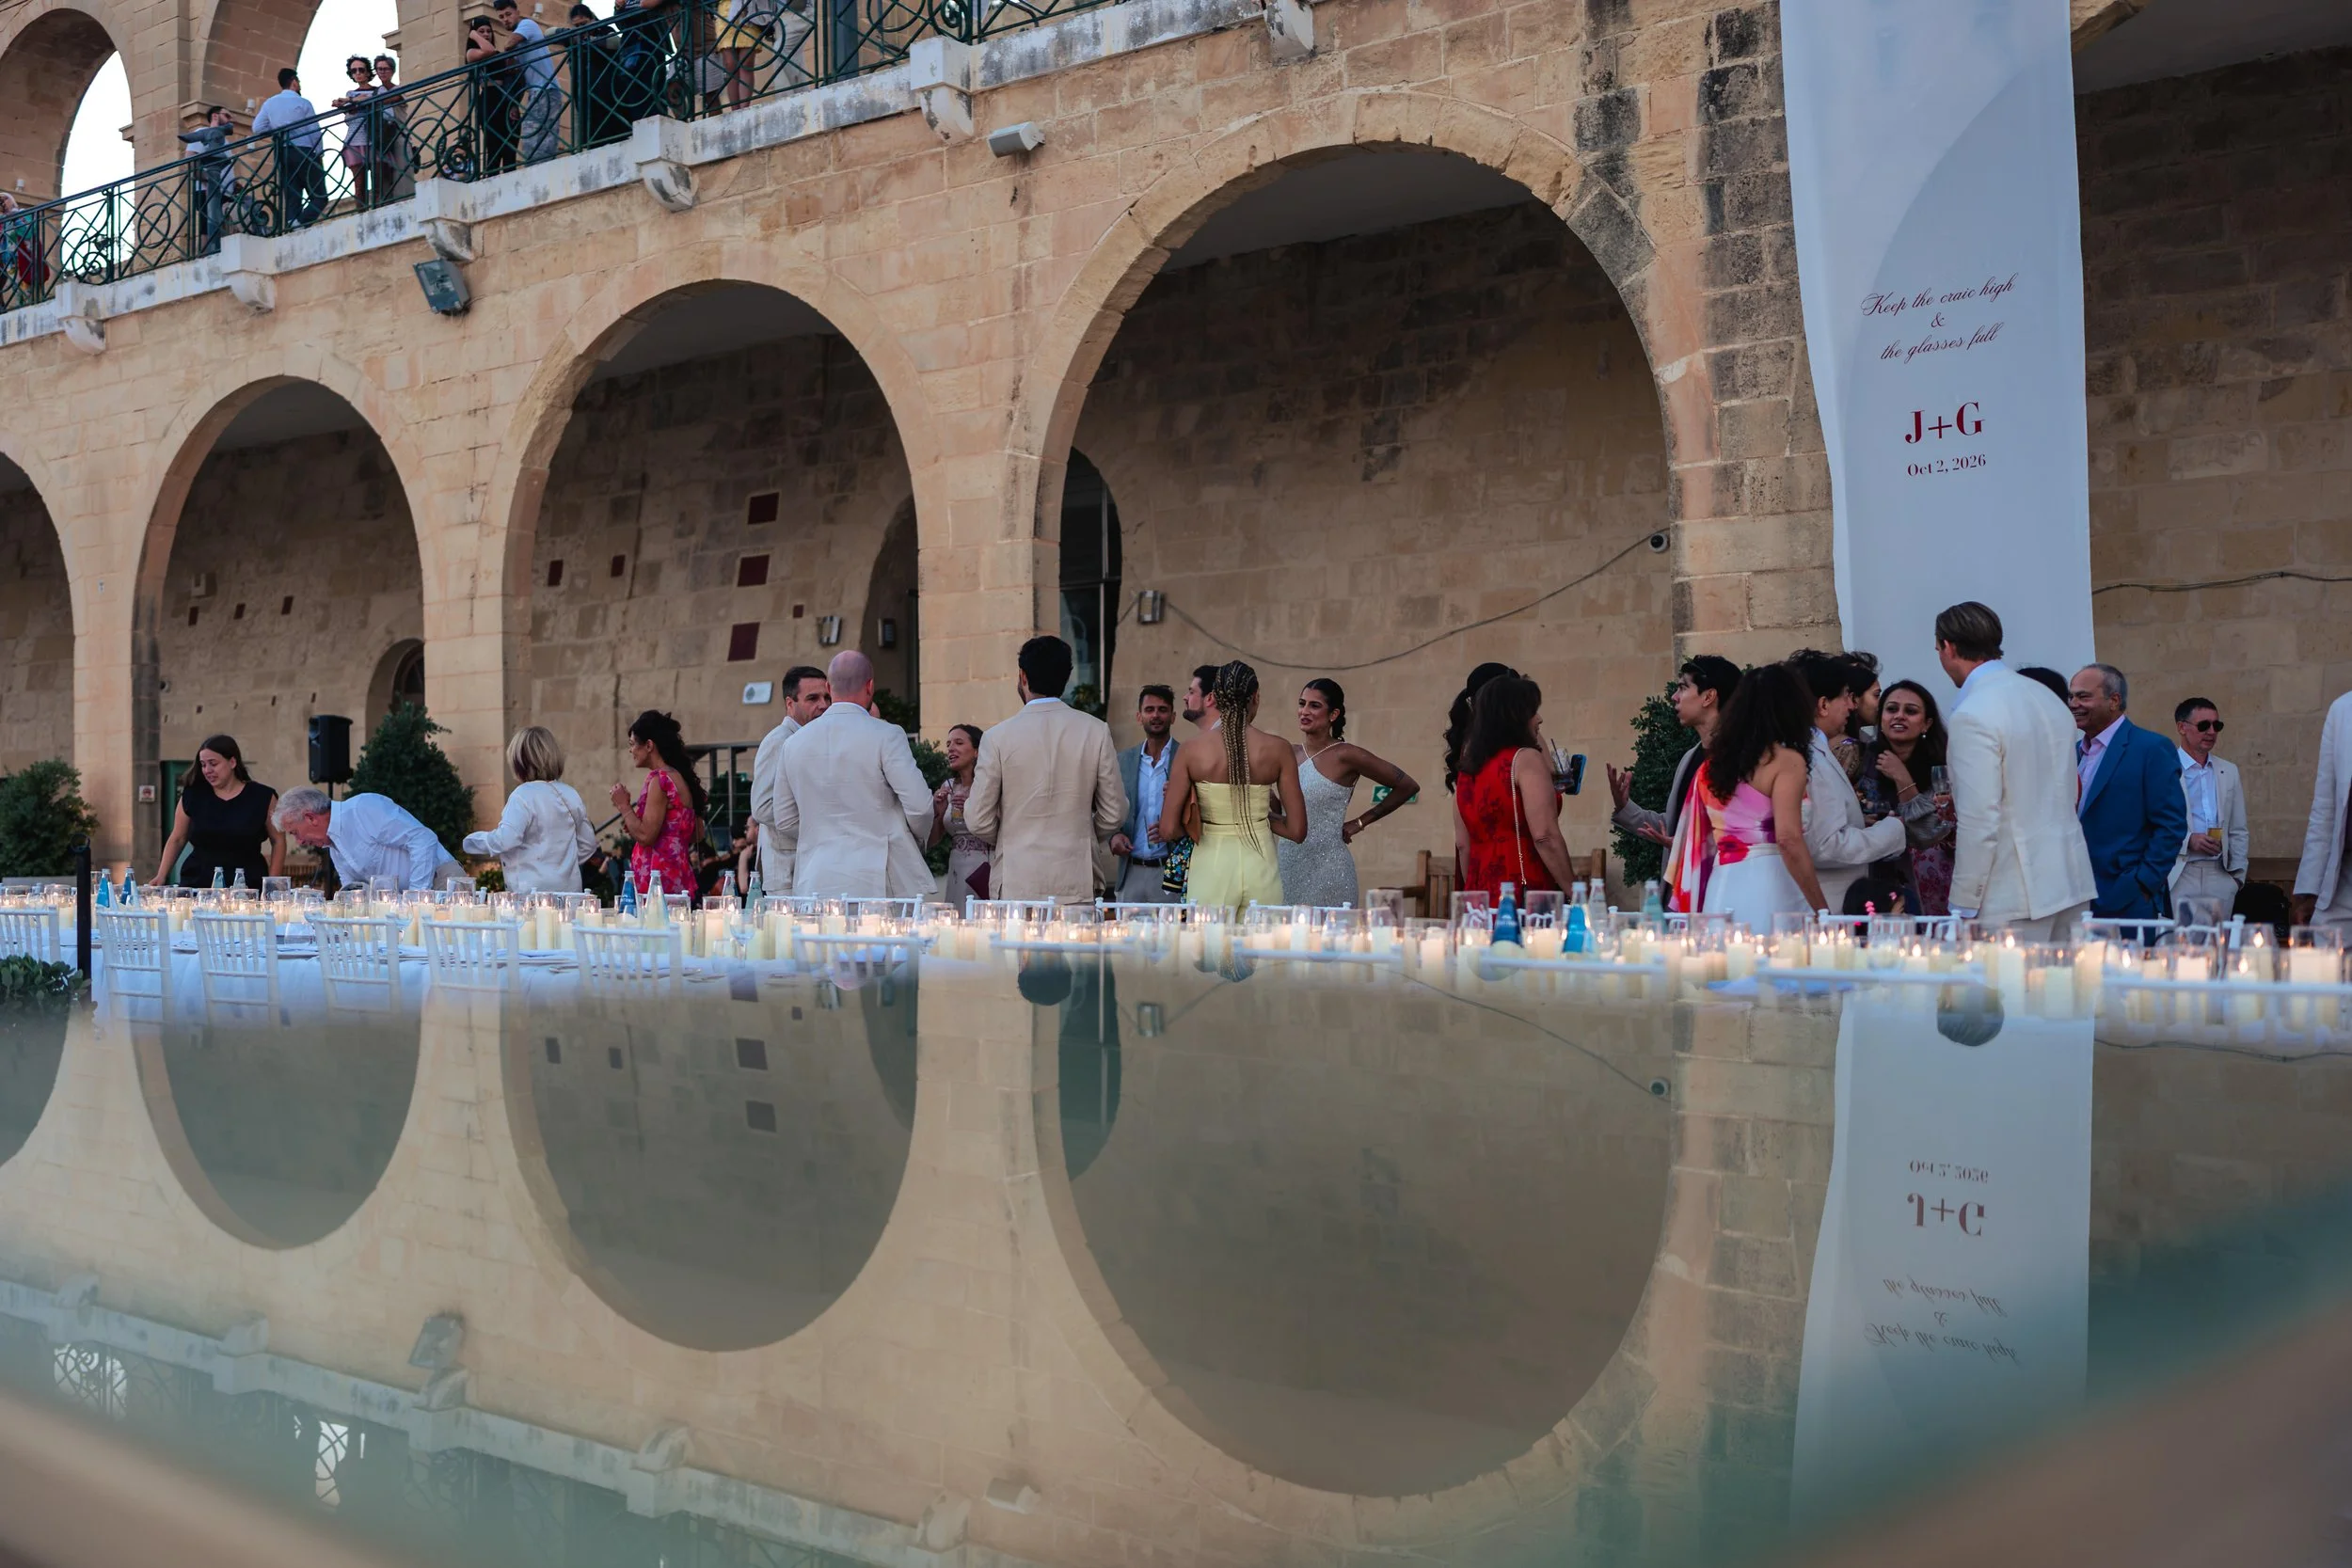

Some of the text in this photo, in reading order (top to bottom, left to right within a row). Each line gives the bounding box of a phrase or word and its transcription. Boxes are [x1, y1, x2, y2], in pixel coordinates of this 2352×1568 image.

[1861, 272, 2019, 316] Keep the craic high
[1931, 311, 1946, 327] &
[1880, 322, 2005, 364] the glasses full
[1904, 401, 1986, 445] J+G
[1907, 463, 1932, 477] Oct
[1951, 453, 1987, 471] 2026
